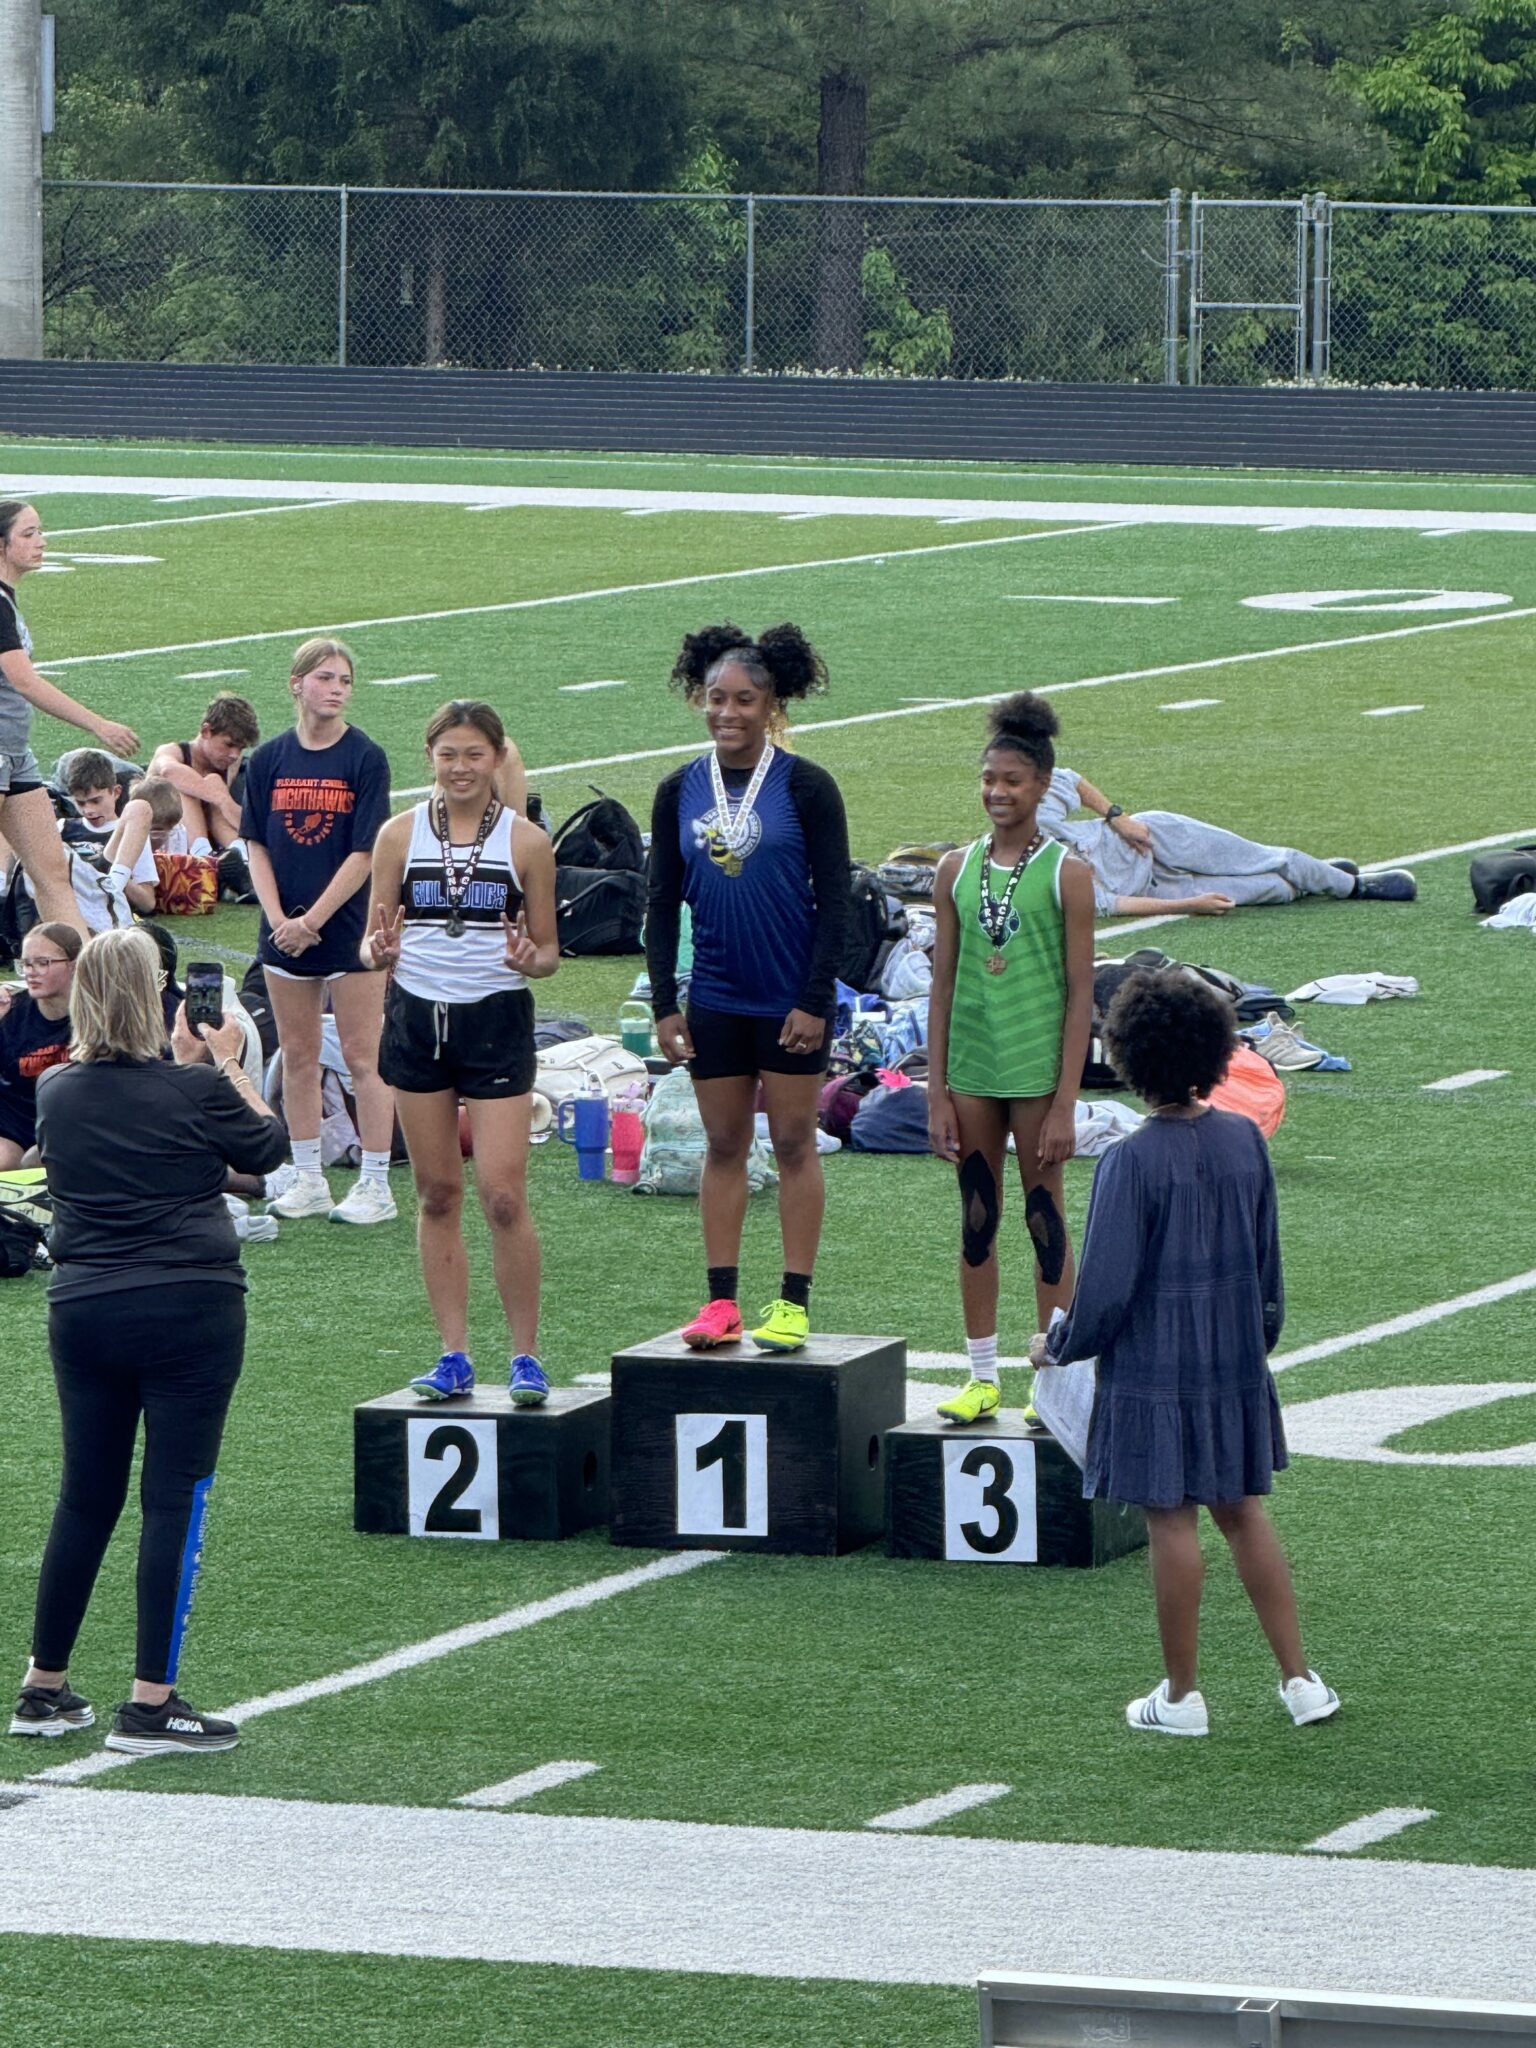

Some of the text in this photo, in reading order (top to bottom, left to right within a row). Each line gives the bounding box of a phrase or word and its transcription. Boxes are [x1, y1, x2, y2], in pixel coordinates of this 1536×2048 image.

[412, 880, 508, 910] BULOGS
[442, 840, 482, 896] SECOND PLACE
[981, 877, 1018, 929] THIRD PLACE
[423, 1425, 482, 1533] 2
[696, 1420, 748, 1529] 1
[959, 1445, 1020, 1554] 3
[165, 1716, 205, 1734] HOKA
